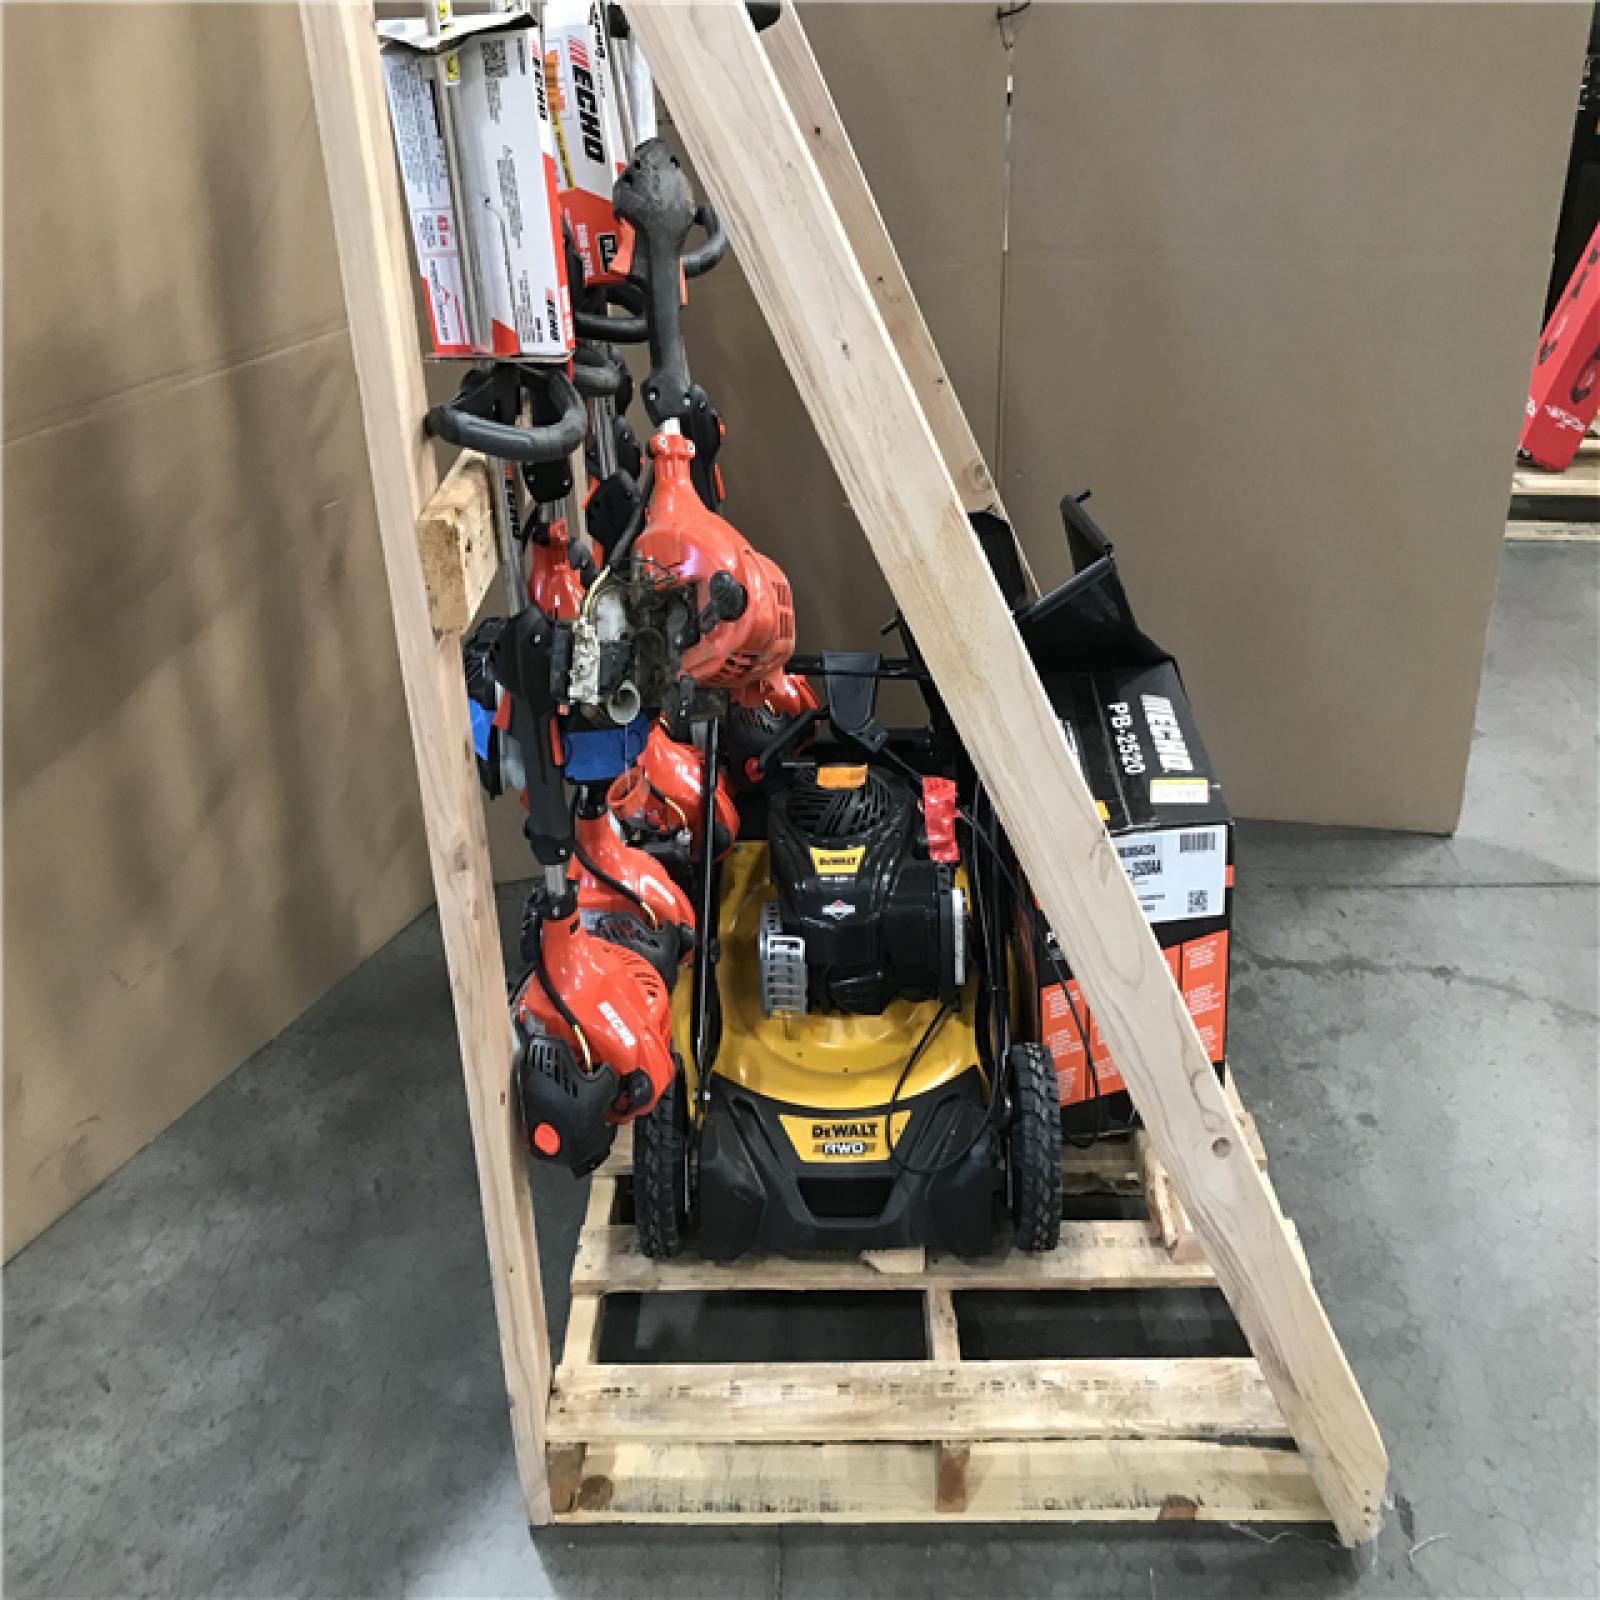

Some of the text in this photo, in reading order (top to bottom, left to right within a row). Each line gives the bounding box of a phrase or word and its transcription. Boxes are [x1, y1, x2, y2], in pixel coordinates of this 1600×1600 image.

[533, 56, 548, 121] ECHO
[572, 65, 605, 165] ECHO
[1107, 702, 1146, 775] PB-2520
